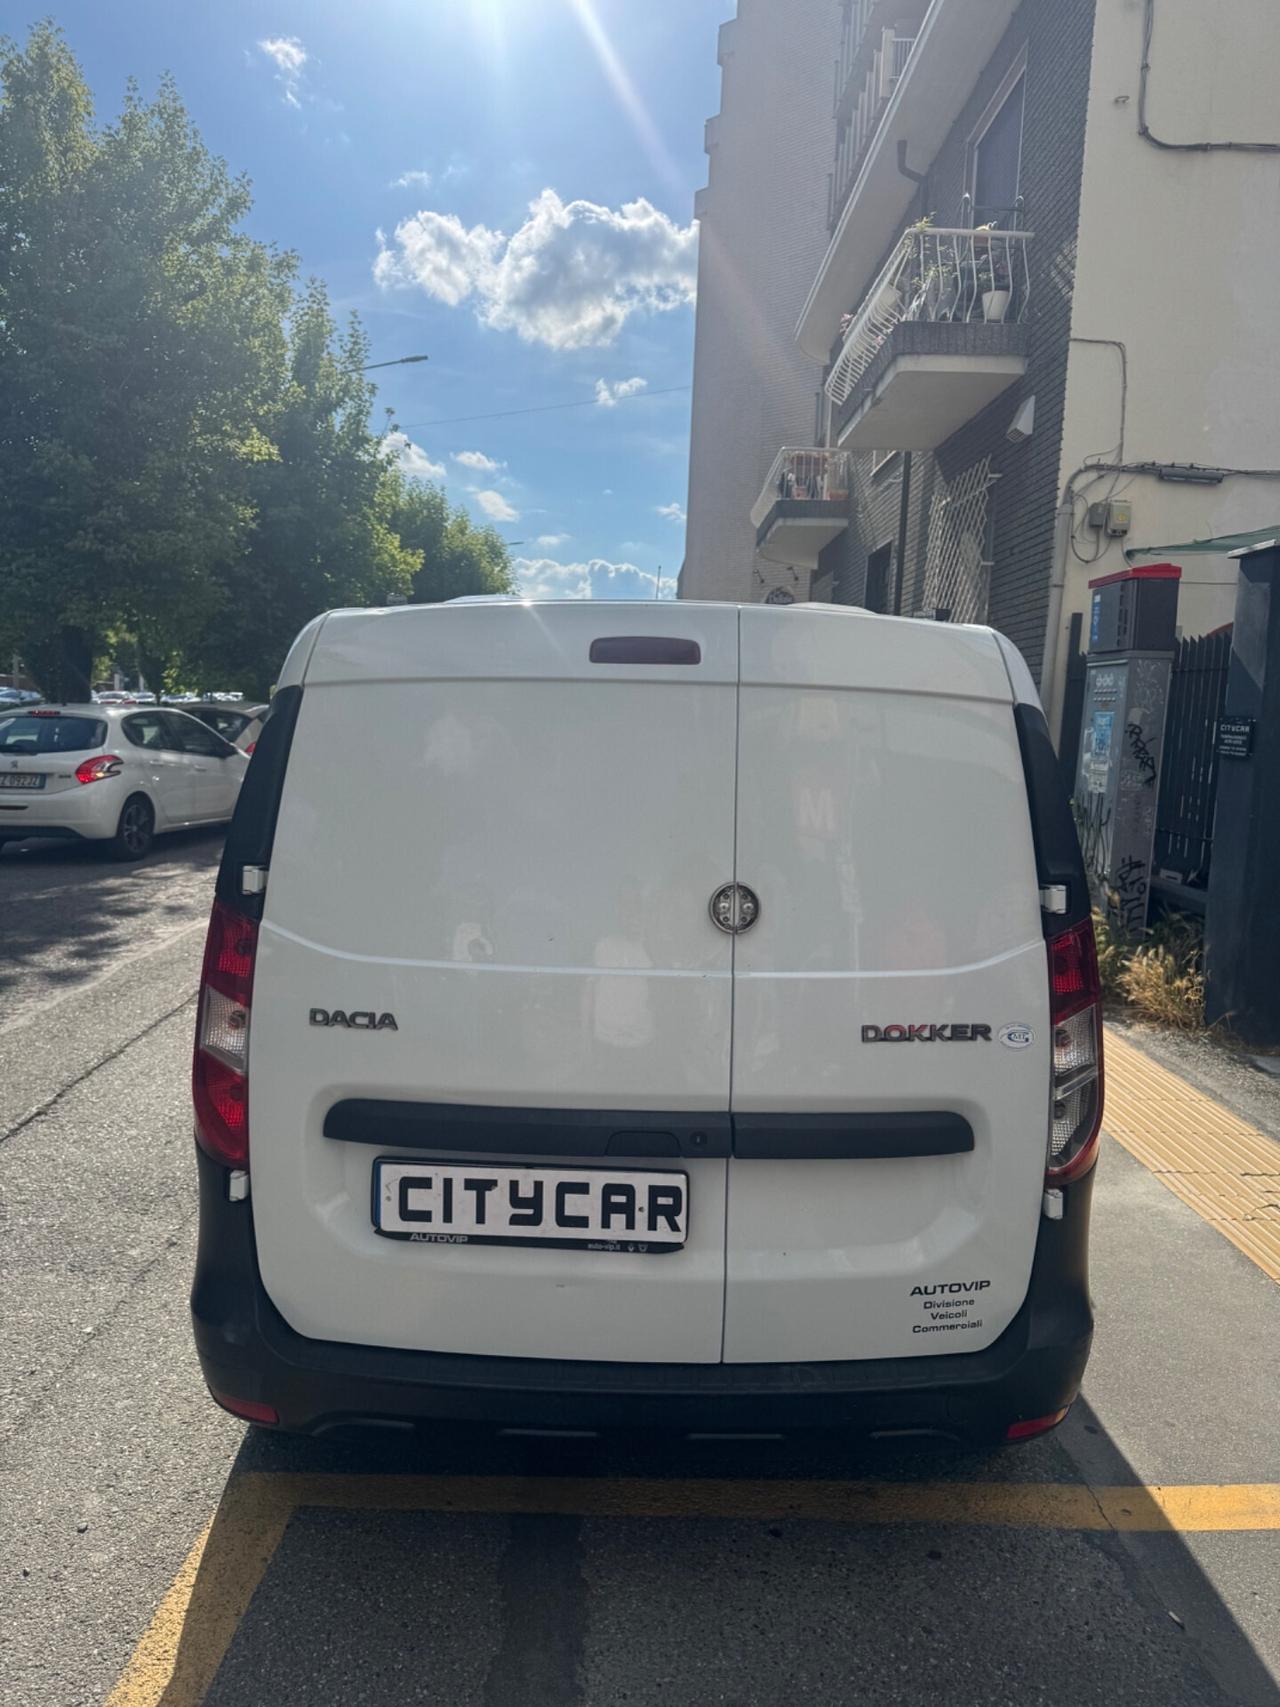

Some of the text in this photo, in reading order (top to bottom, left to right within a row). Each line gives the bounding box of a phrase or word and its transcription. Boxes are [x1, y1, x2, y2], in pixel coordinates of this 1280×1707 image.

[309, 1007, 399, 1031] DACIA
[861, 1023, 992, 1043] DOKKER
[399, 1176, 682, 1232] CITYCAR
[410, 1232, 469, 1244] AUTOVIP
[910, 1280, 991, 1296] AUTOVIP
[923, 1299, 975, 1310] Divisione
[930, 1309, 968, 1321] Veicoli
[912, 1320, 983, 1333] Commerciali
